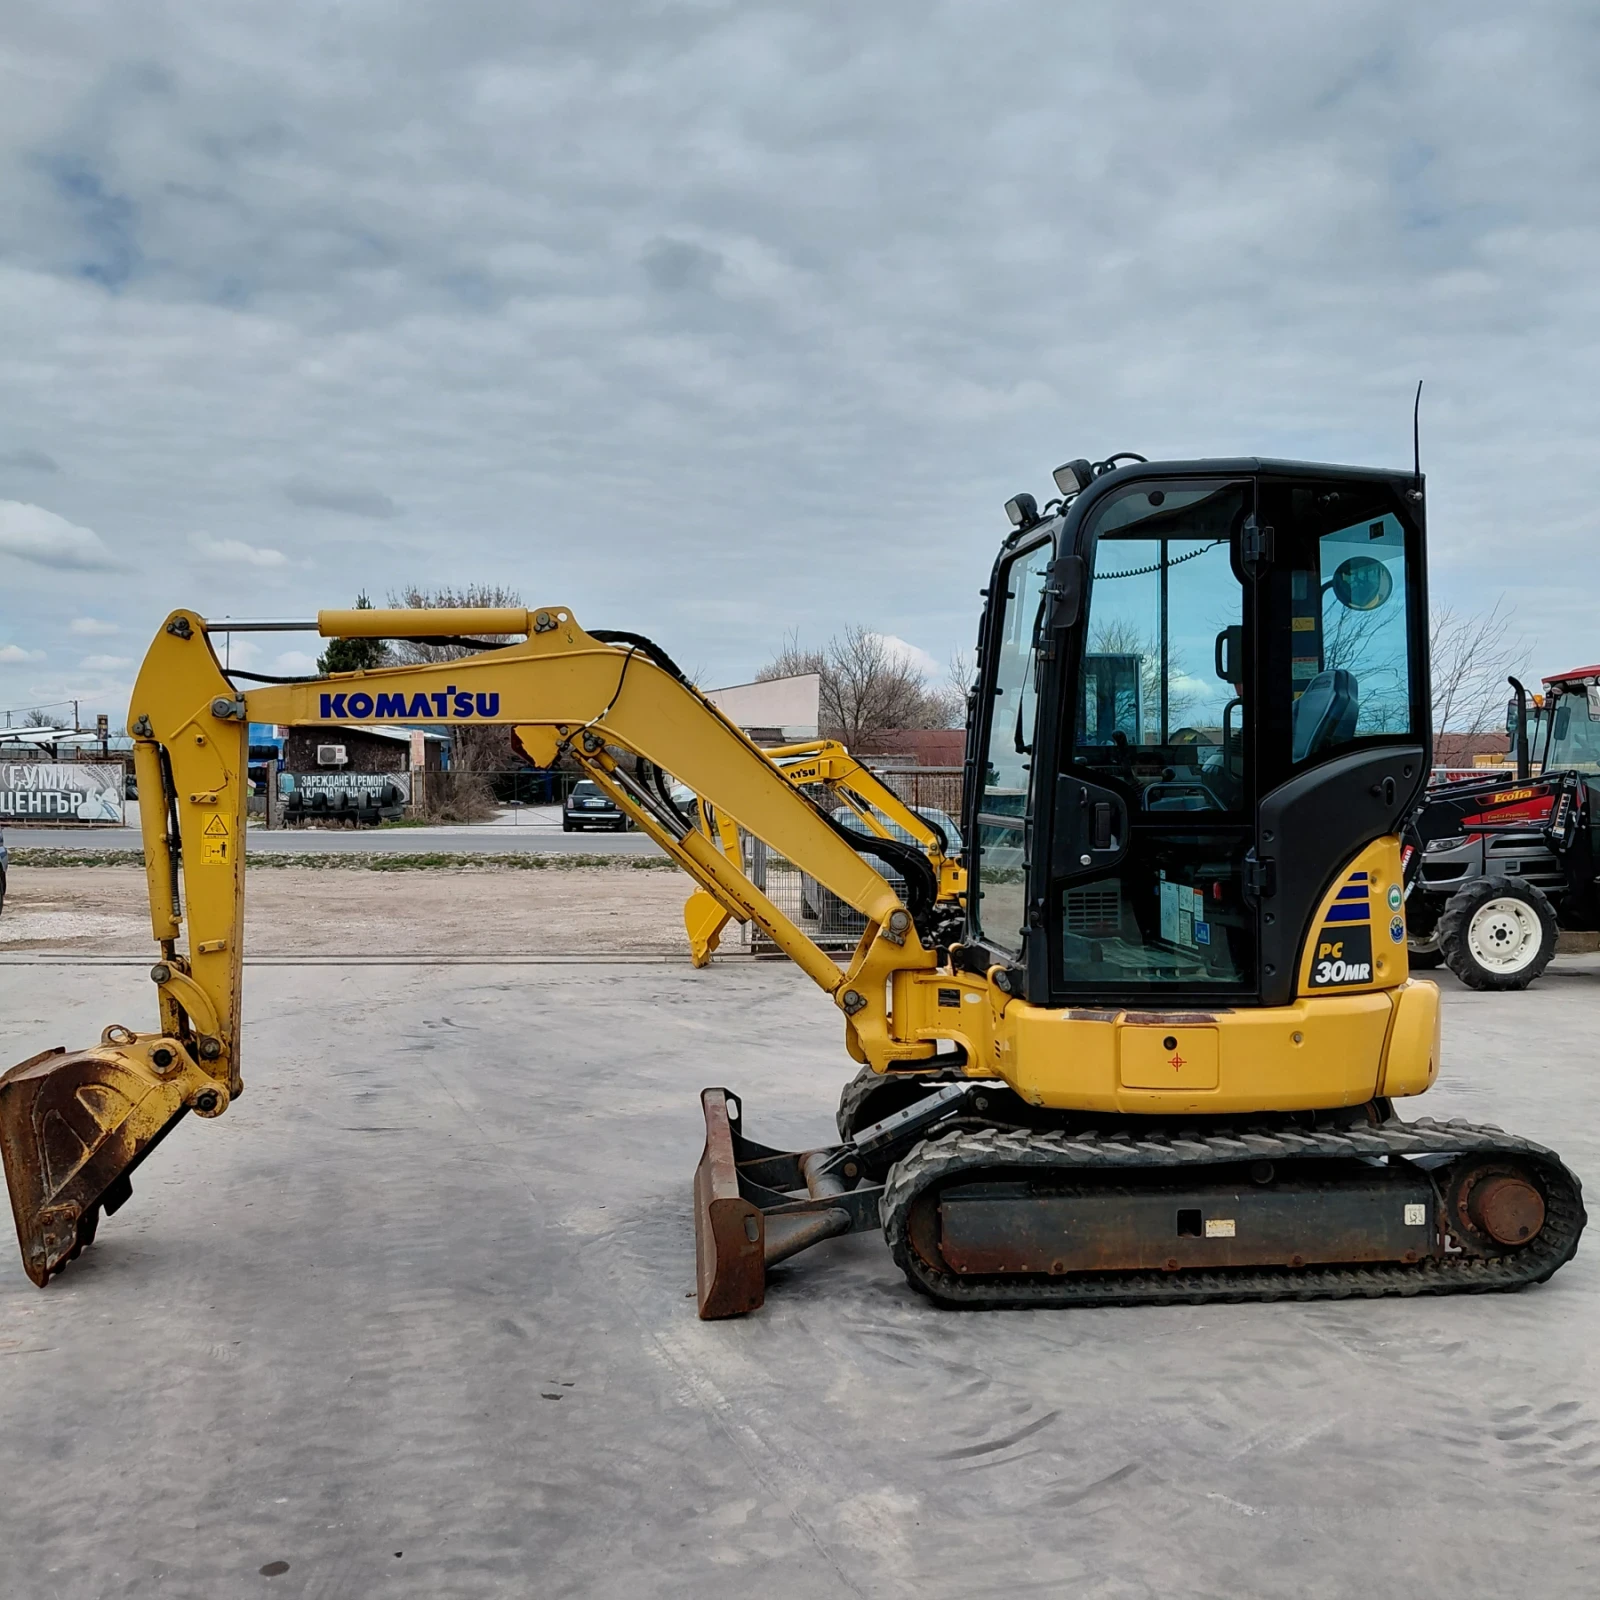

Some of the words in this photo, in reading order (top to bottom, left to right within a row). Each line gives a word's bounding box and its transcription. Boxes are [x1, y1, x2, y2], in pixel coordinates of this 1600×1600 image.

[320, 685, 500, 718] KOMATSU
[9, 765, 75, 791] ГУМИ
[301, 775, 349, 787] ЗАРЕЖДАНЕ
[350, 775, 357, 787] И
[358, 775, 388, 787] РЕМОНТ
[789, 768, 816, 779] ATSU
[0, 791, 82, 815] ЦЕНТЪР
[1493, 789, 1532, 803] EcoTra
[1318, 941, 1344, 959] PC
[1315, 960, 1370, 983] 30MR
